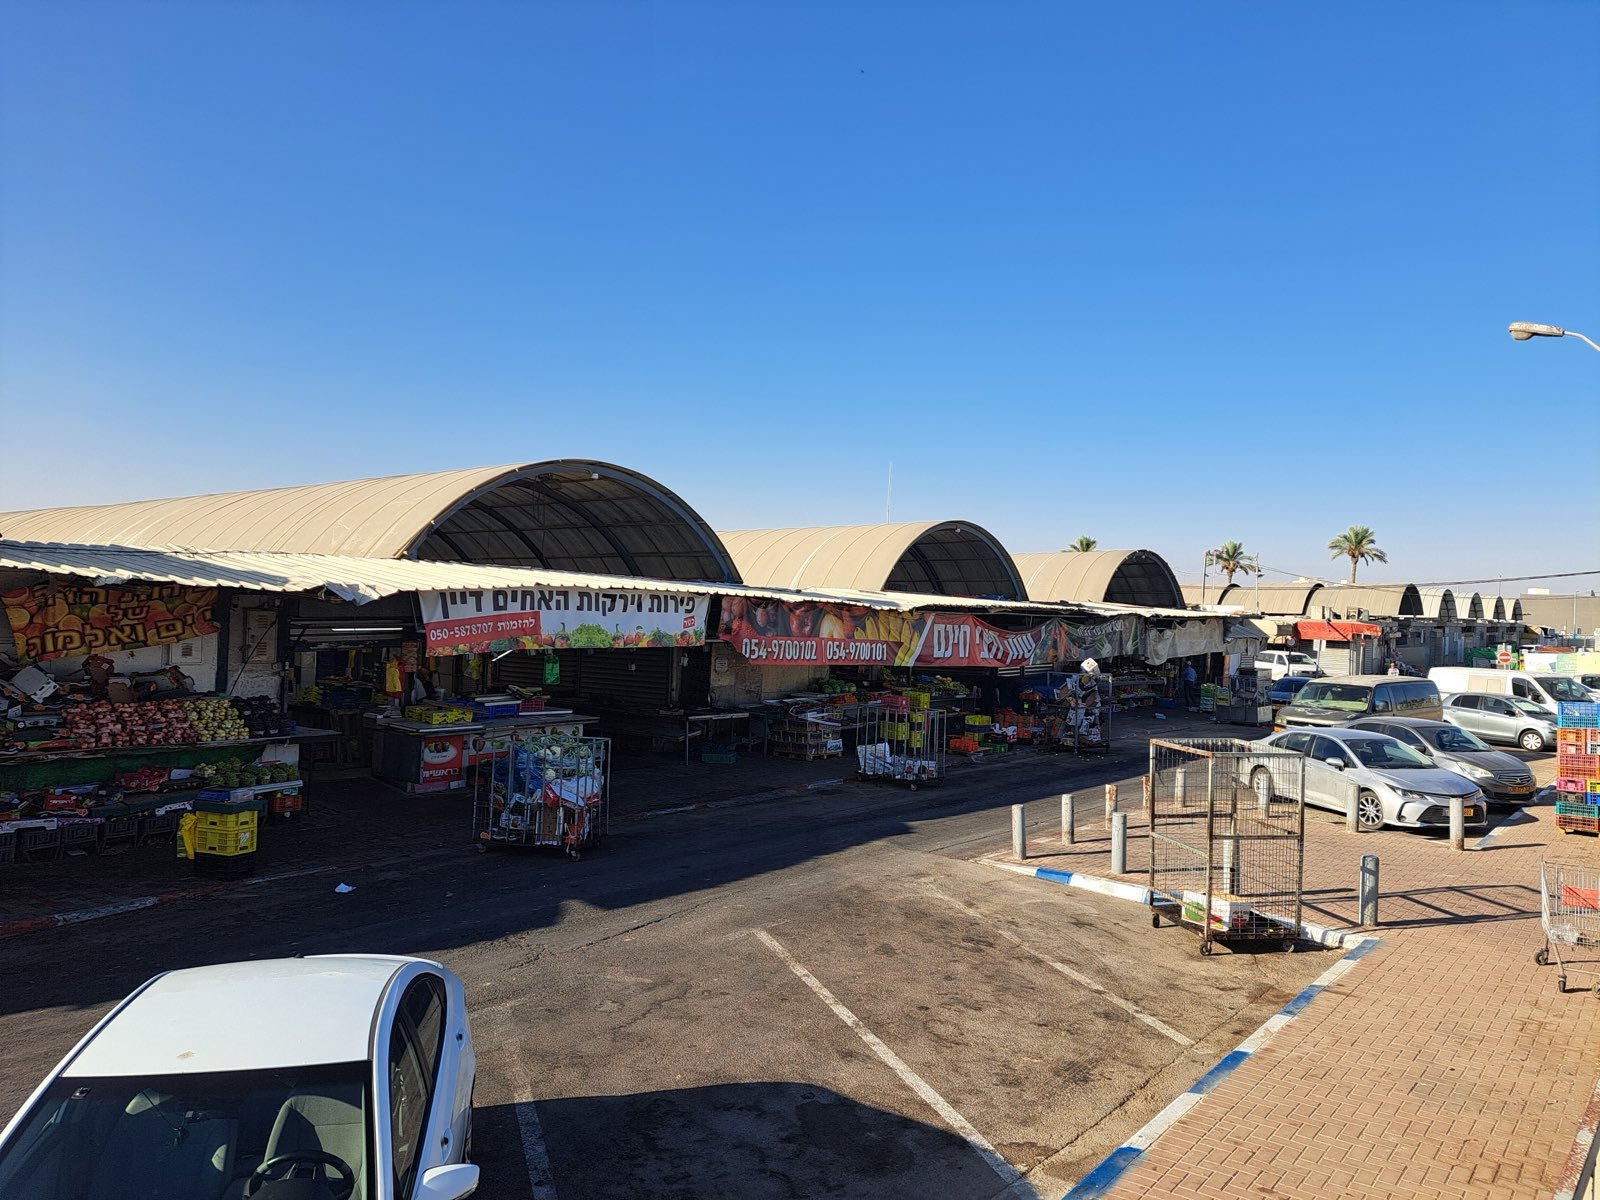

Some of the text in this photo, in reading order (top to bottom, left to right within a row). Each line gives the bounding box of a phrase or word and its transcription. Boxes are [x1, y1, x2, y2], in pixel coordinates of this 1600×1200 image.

[108, 604, 151, 622] של
[440, 589, 696, 619] פירות וירקות האחים דיין
[26, 622, 149, 660] ואלמוג
[430, 616, 536, 641] להזמנות 050-5878707
[933, 623, 971, 658] חינם
[742, 637, 887, 661] 054-9700102 054-9700101
